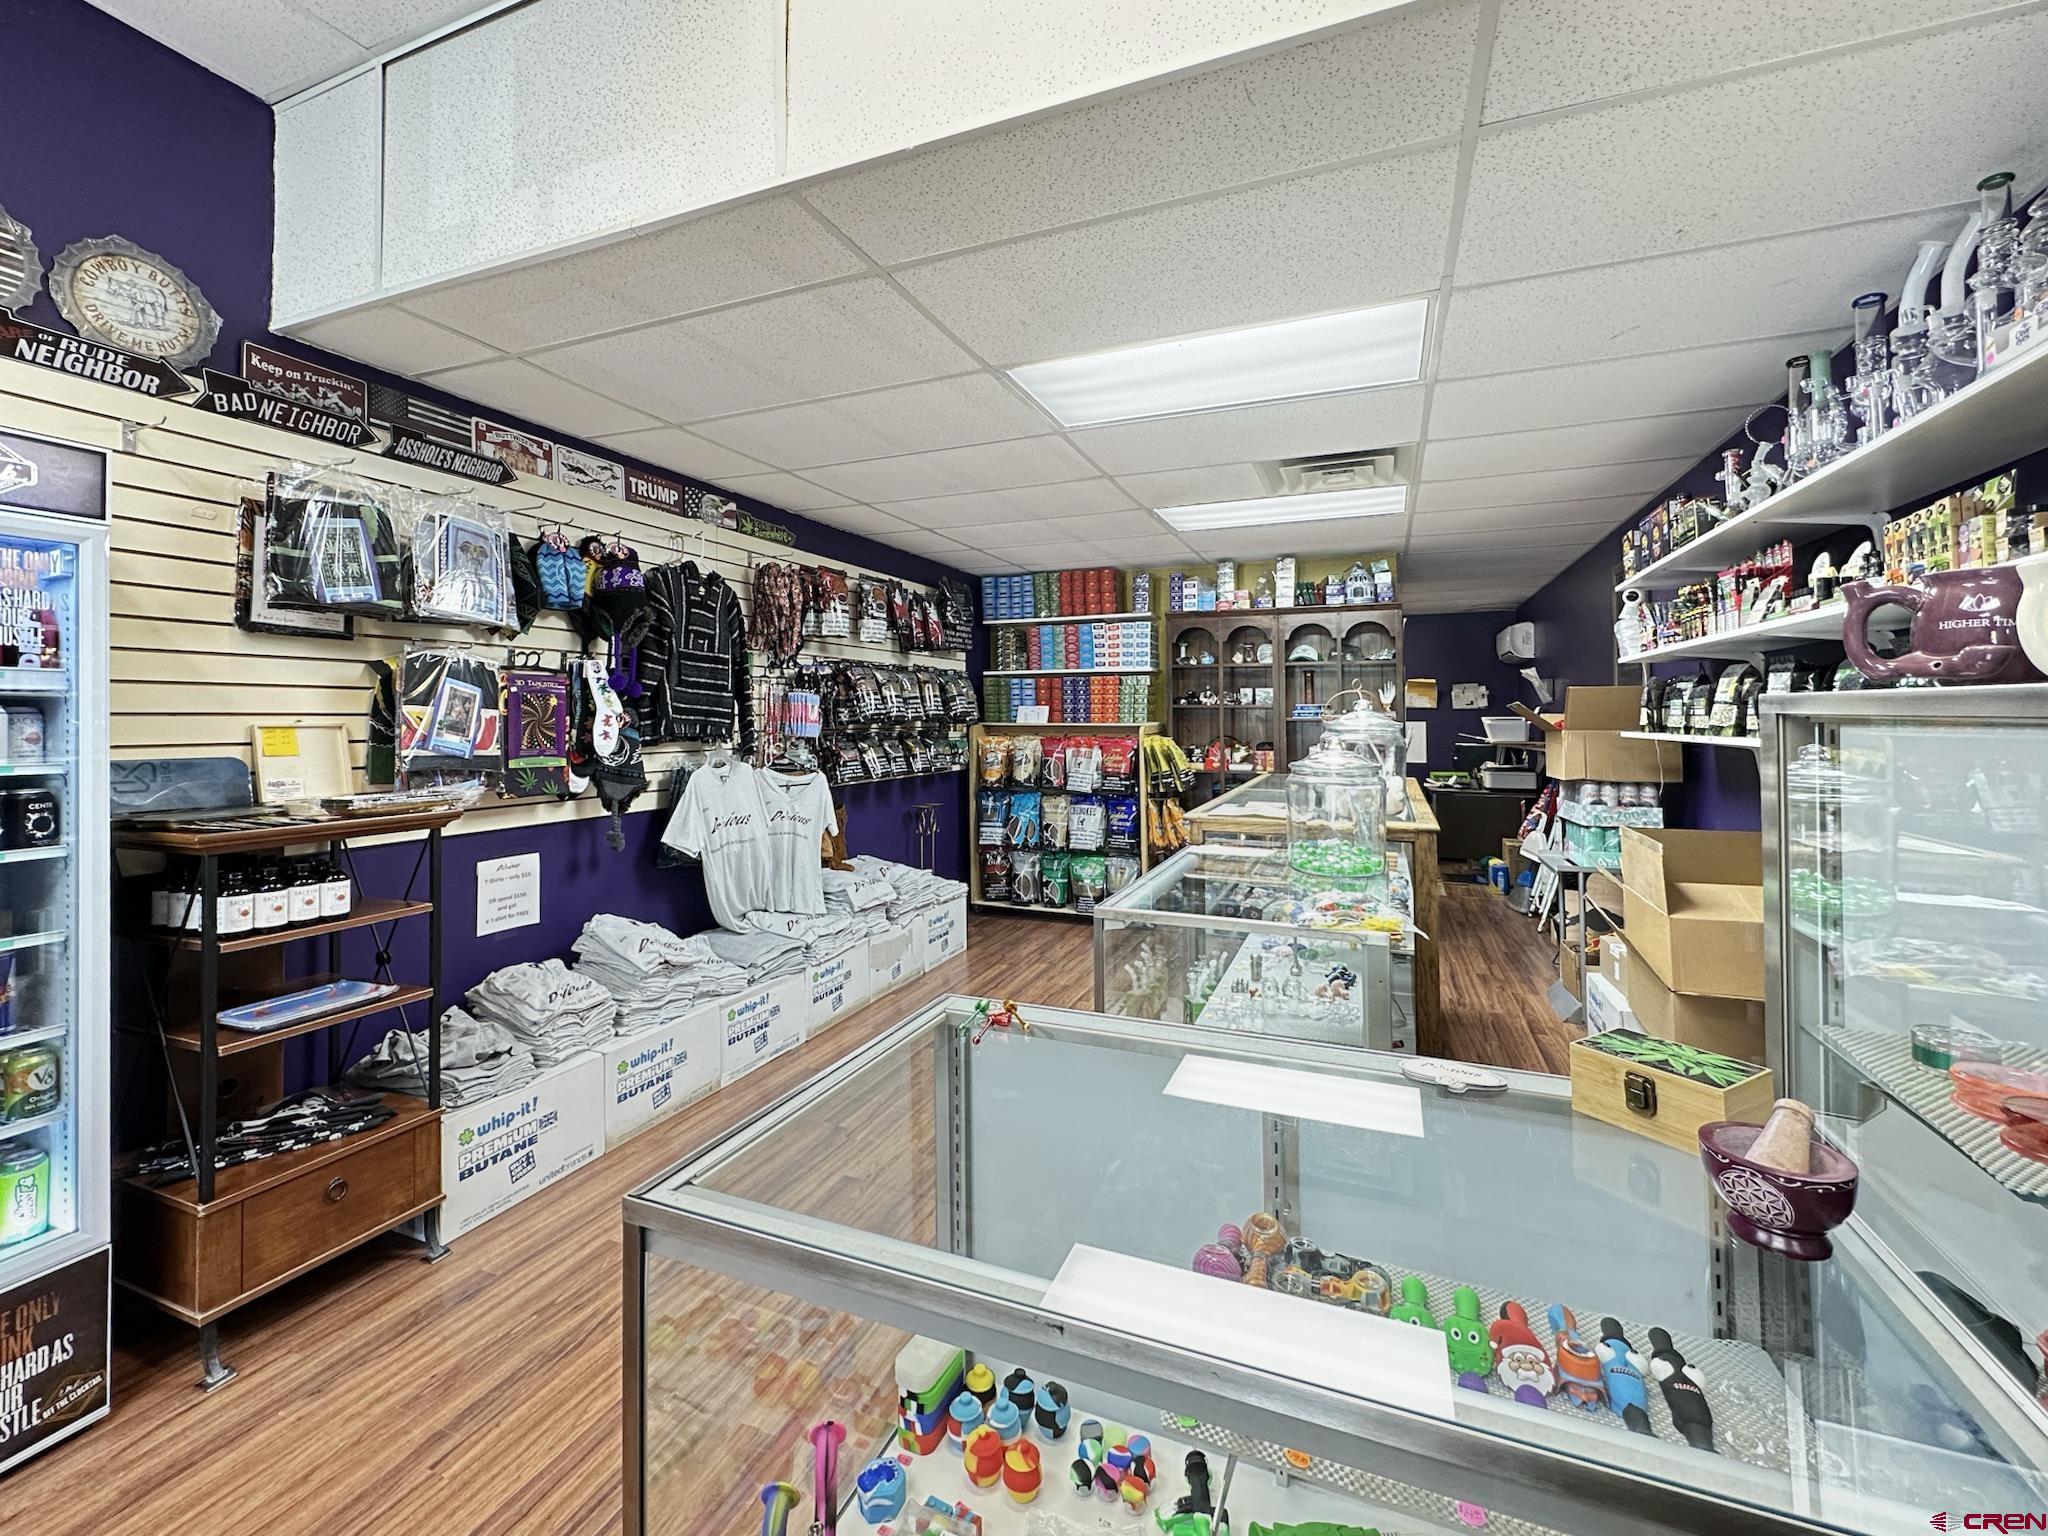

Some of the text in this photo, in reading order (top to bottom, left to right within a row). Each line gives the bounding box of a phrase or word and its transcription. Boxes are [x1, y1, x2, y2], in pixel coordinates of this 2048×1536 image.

[80, 258, 193, 317] COWBOY BUTTS
[85, 304, 127, 341] DRIVE
[15, 338, 160, 395] NEIGHBOR
[59, 337, 131, 368] RUDE
[250, 352, 284, 378] Keep
[285, 369, 301, 380] on
[213, 392, 362, 445] BAD NEIGHBOR
[395, 436, 504, 482] ASSHOLE'S NEIGHBOR
[629, 476, 679, 505] TRUMP
[1939, 618, 1991, 630] HIGHER
[737, 993, 769, 1016] whip-it!
[813, 984, 844, 1005] BUTANE
[728, 1021, 770, 1046] BUTANE
[630, 1038, 674, 1068] whip-it!
[34, 1067, 53, 1085] V8
[617, 1070, 673, 1104] BUTANE
[477, 1096, 538, 1137] whip-it!
[459, 1135, 538, 1182] BUTANE
[15, 1291, 61, 1332] ONLY
[0, 1333, 74, 1391] HARD AS
